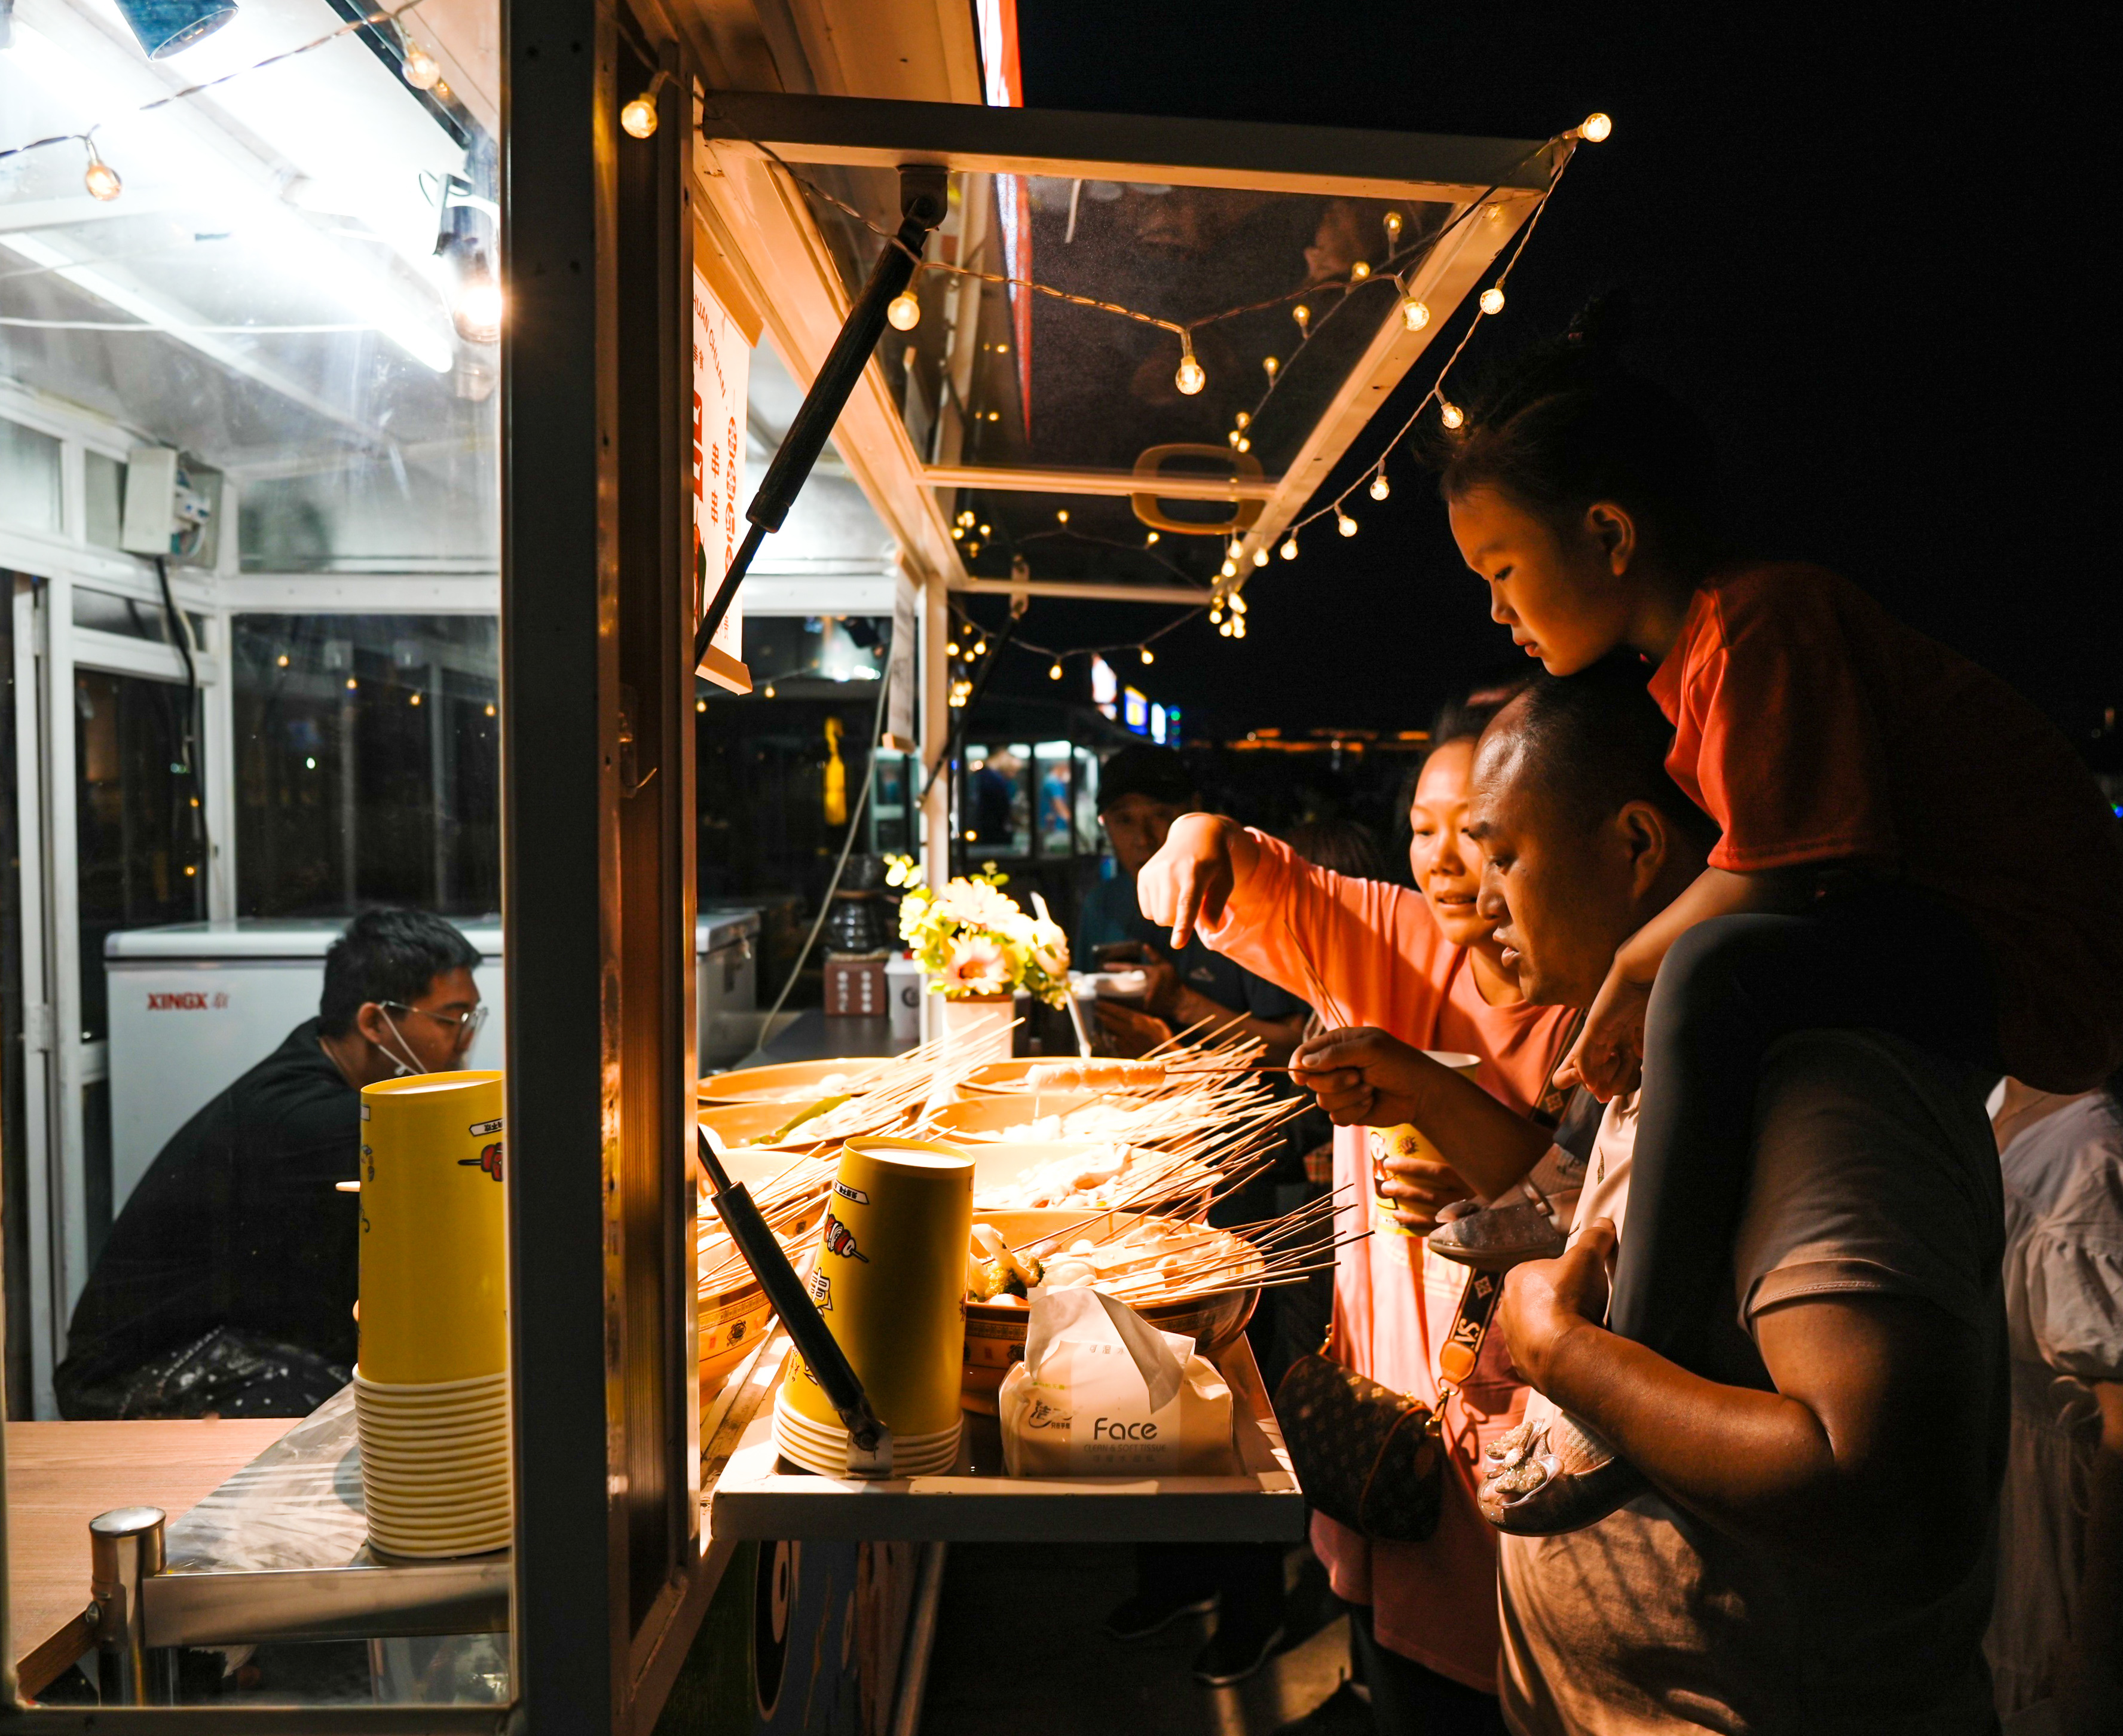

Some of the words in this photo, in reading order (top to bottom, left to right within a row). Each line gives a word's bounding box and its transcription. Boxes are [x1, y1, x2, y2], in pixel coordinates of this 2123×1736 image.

[709, 329, 726, 399] CHUAN
[1094, 1417, 1158, 1440] Face
[1084, 1444, 1108, 1452] CLEAN
[1118, 1444, 1137, 1452] SOFT
[1140, 1444, 1166, 1452] TISSUE
